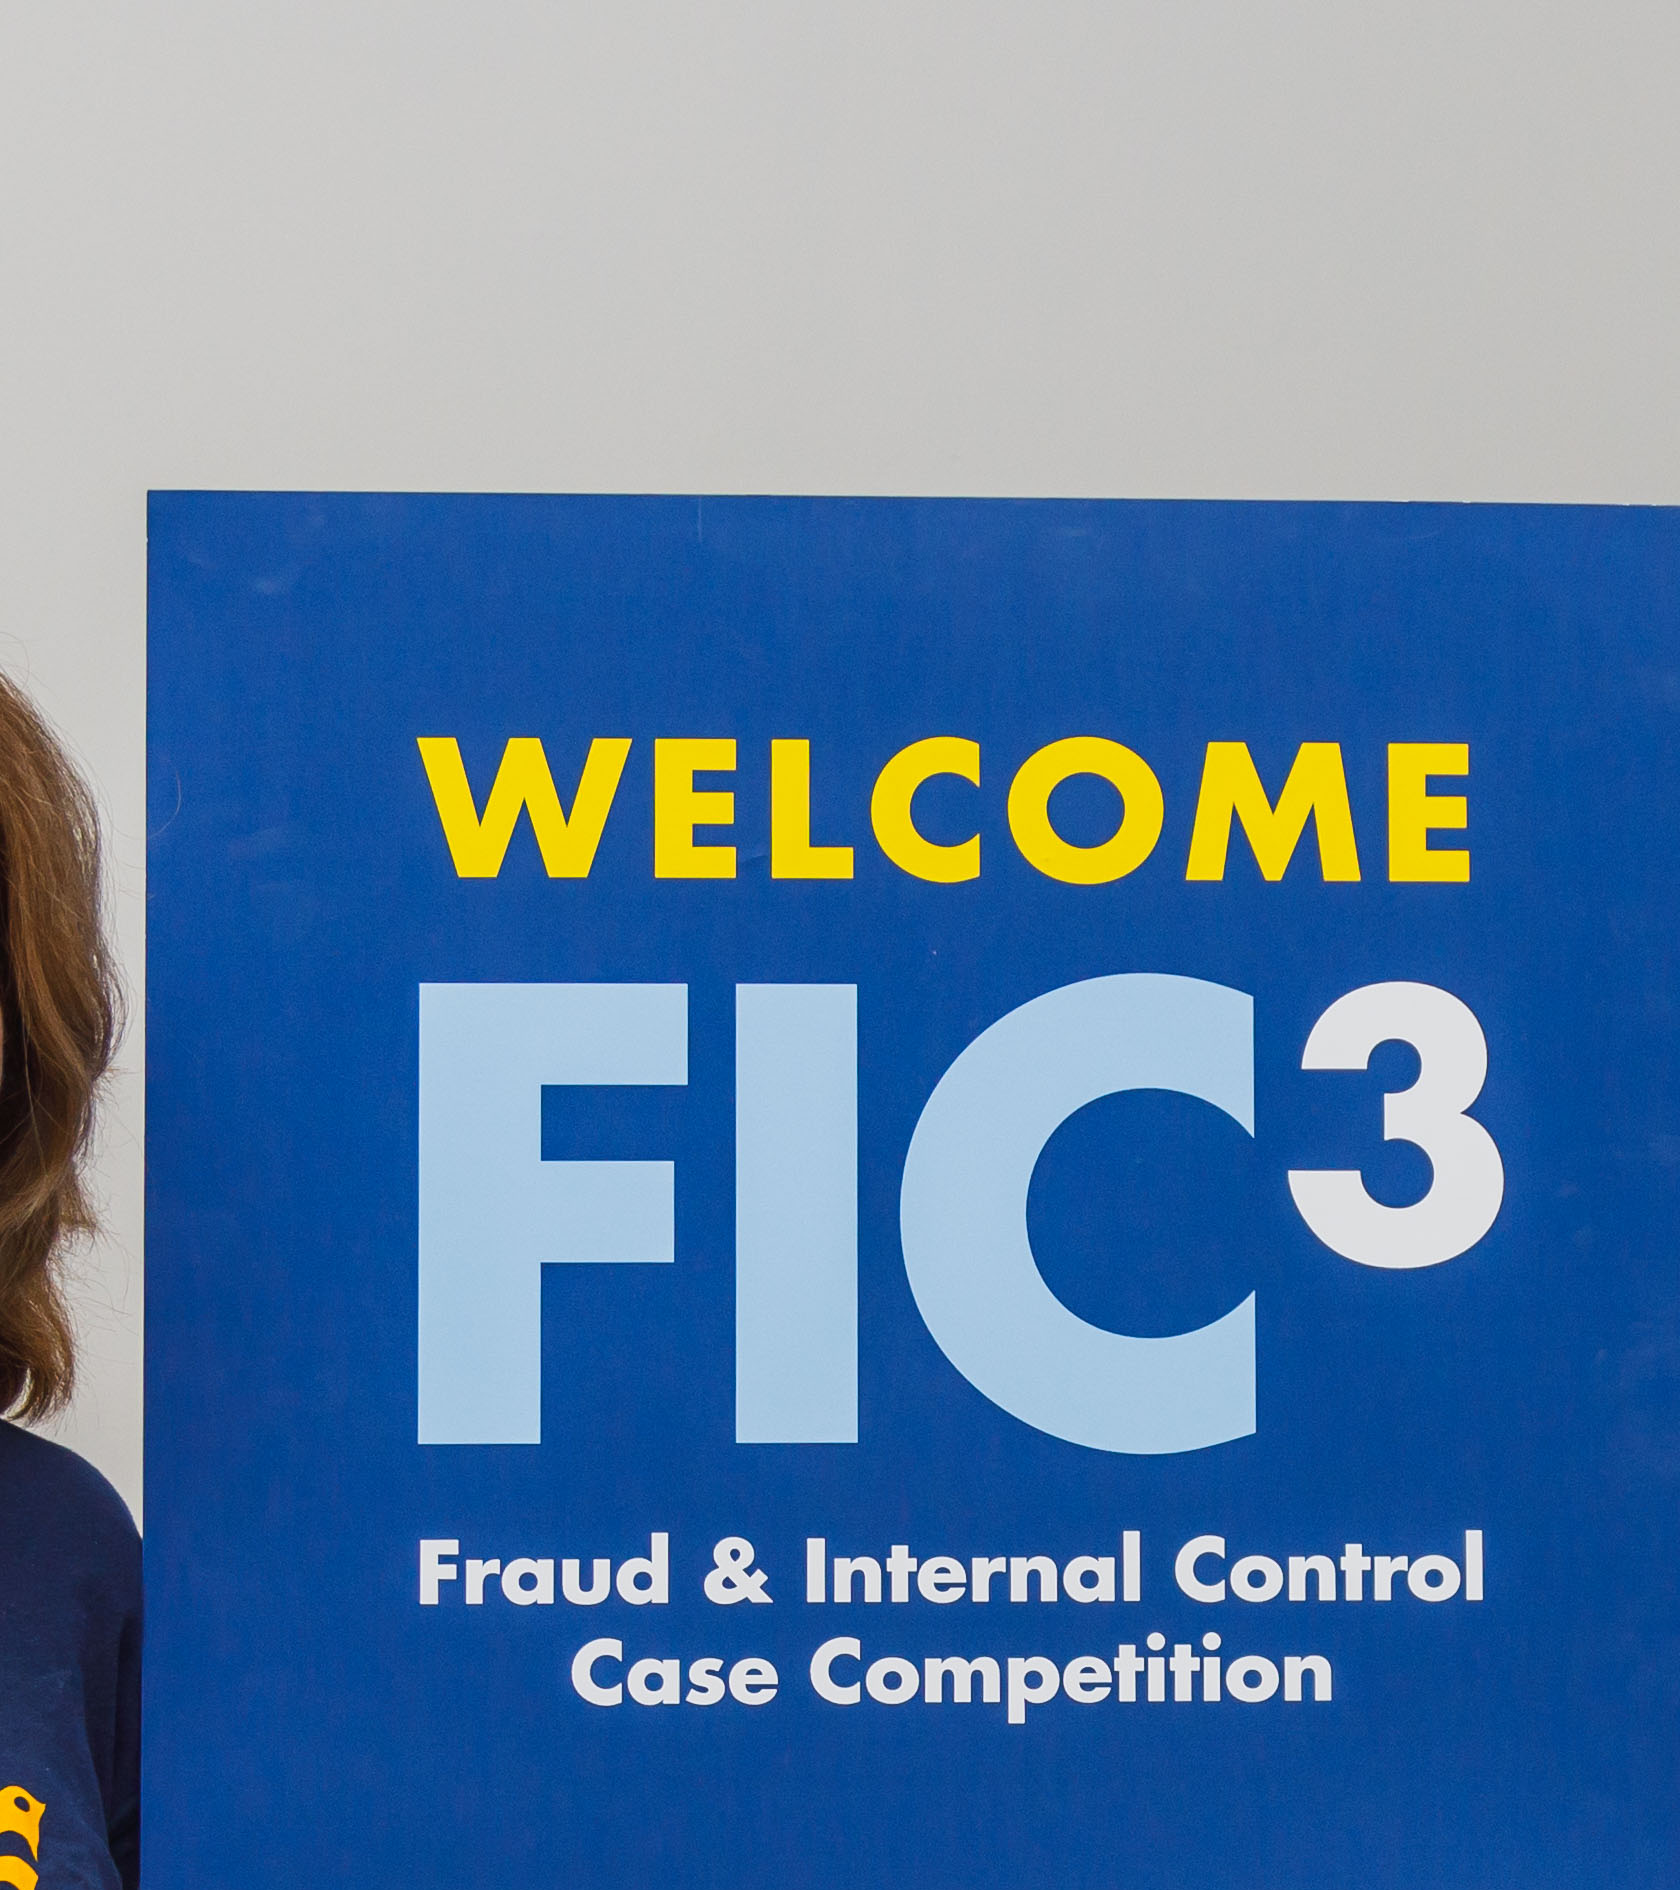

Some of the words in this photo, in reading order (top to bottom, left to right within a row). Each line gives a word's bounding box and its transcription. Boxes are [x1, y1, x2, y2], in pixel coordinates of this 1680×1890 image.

[416, 736, 1471, 885] WELCOME
[418, 1531, 670, 1606] Fraud
[703, 1536, 774, 1605] &
[805, 1529, 1141, 1605] Internal
[1174, 1529, 1484, 1604] Control
[570, 1637, 779, 1707] Case
[809, 1631, 1333, 1725] Competition
